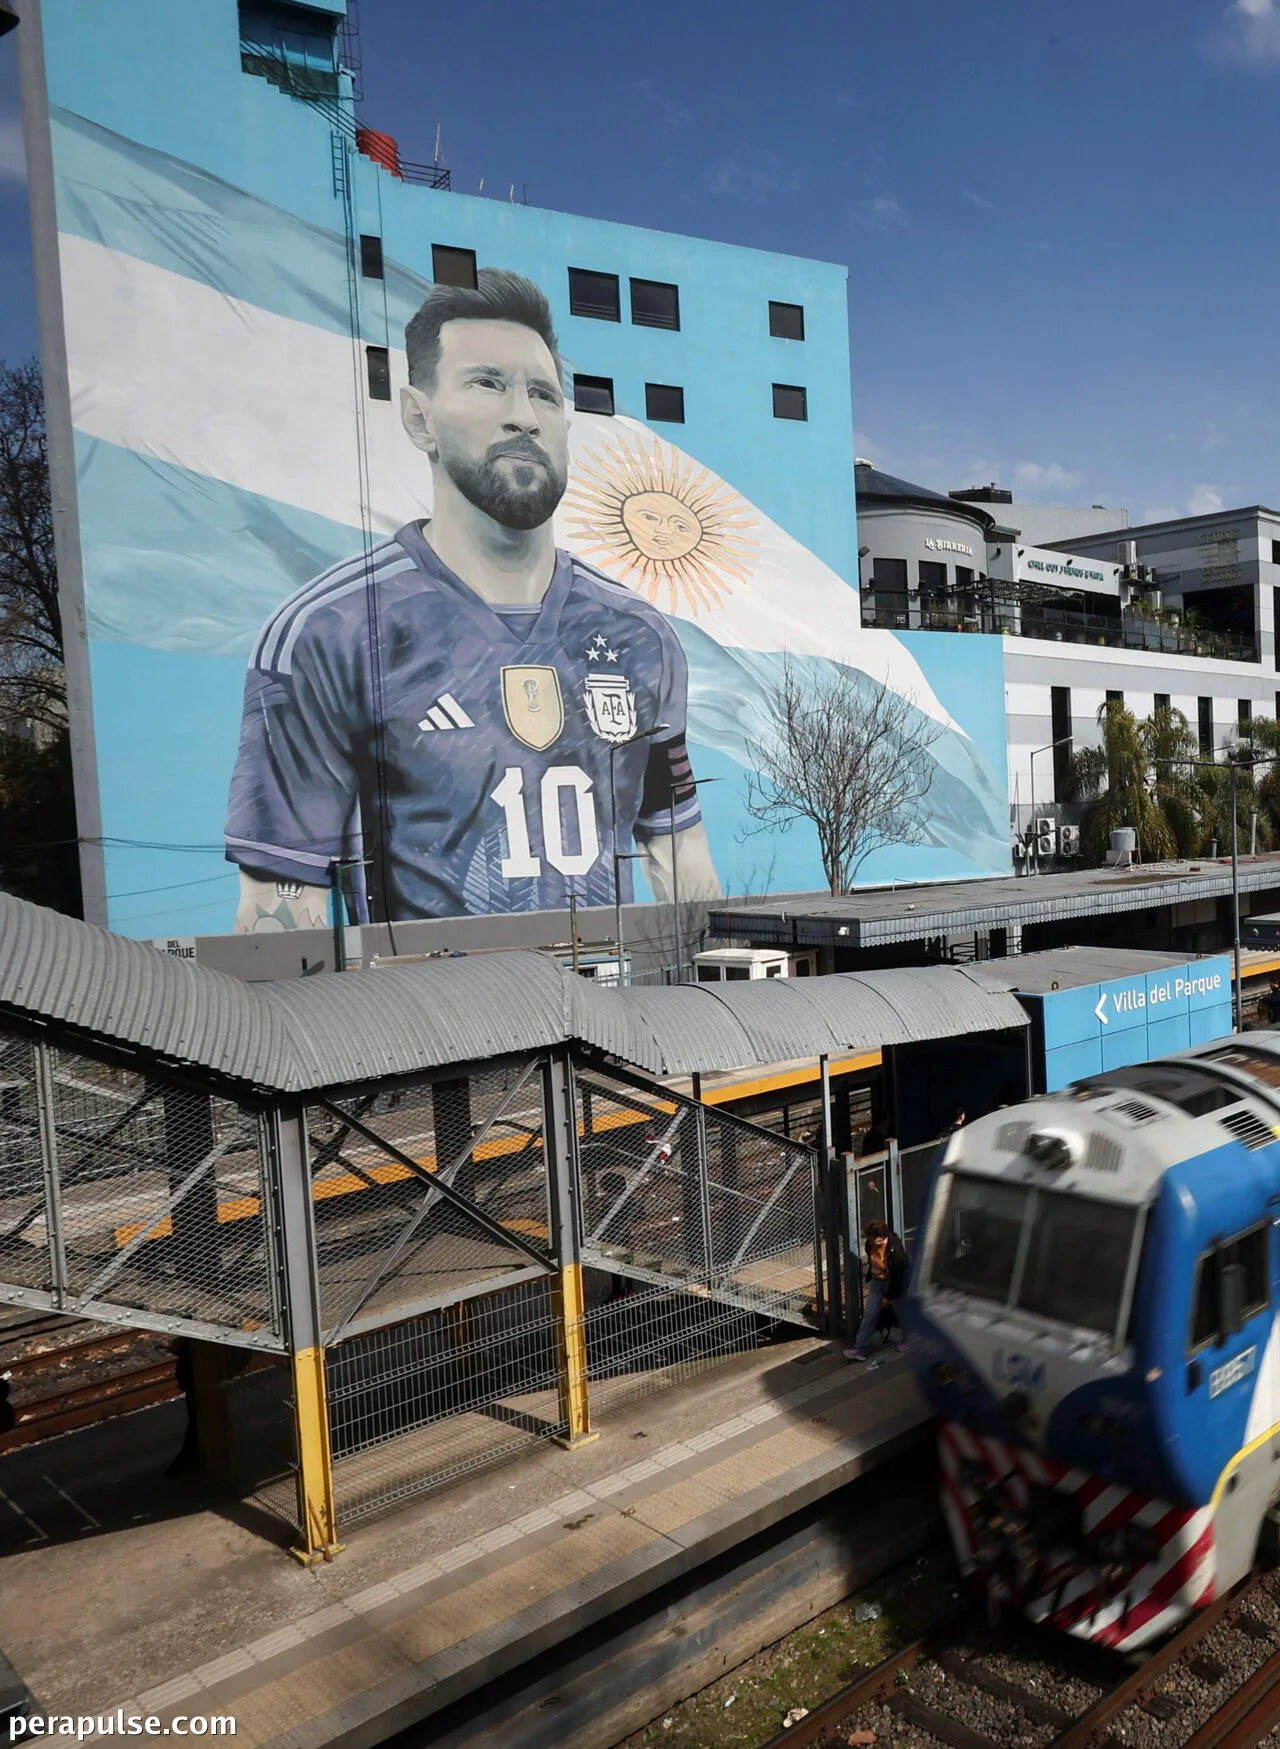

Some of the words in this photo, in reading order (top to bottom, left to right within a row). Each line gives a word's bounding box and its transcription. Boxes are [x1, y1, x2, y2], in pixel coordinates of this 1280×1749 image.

[936, 539, 972, 556] BIRRERIA
[600, 692, 626, 725] AFA
[490, 765, 599, 878] 10
[167, 940, 180, 948] DEL
[1113, 989, 1146, 1014] Villa
[1150, 981, 1171, 1005] del
[1175, 973, 1221, 998] Parque
